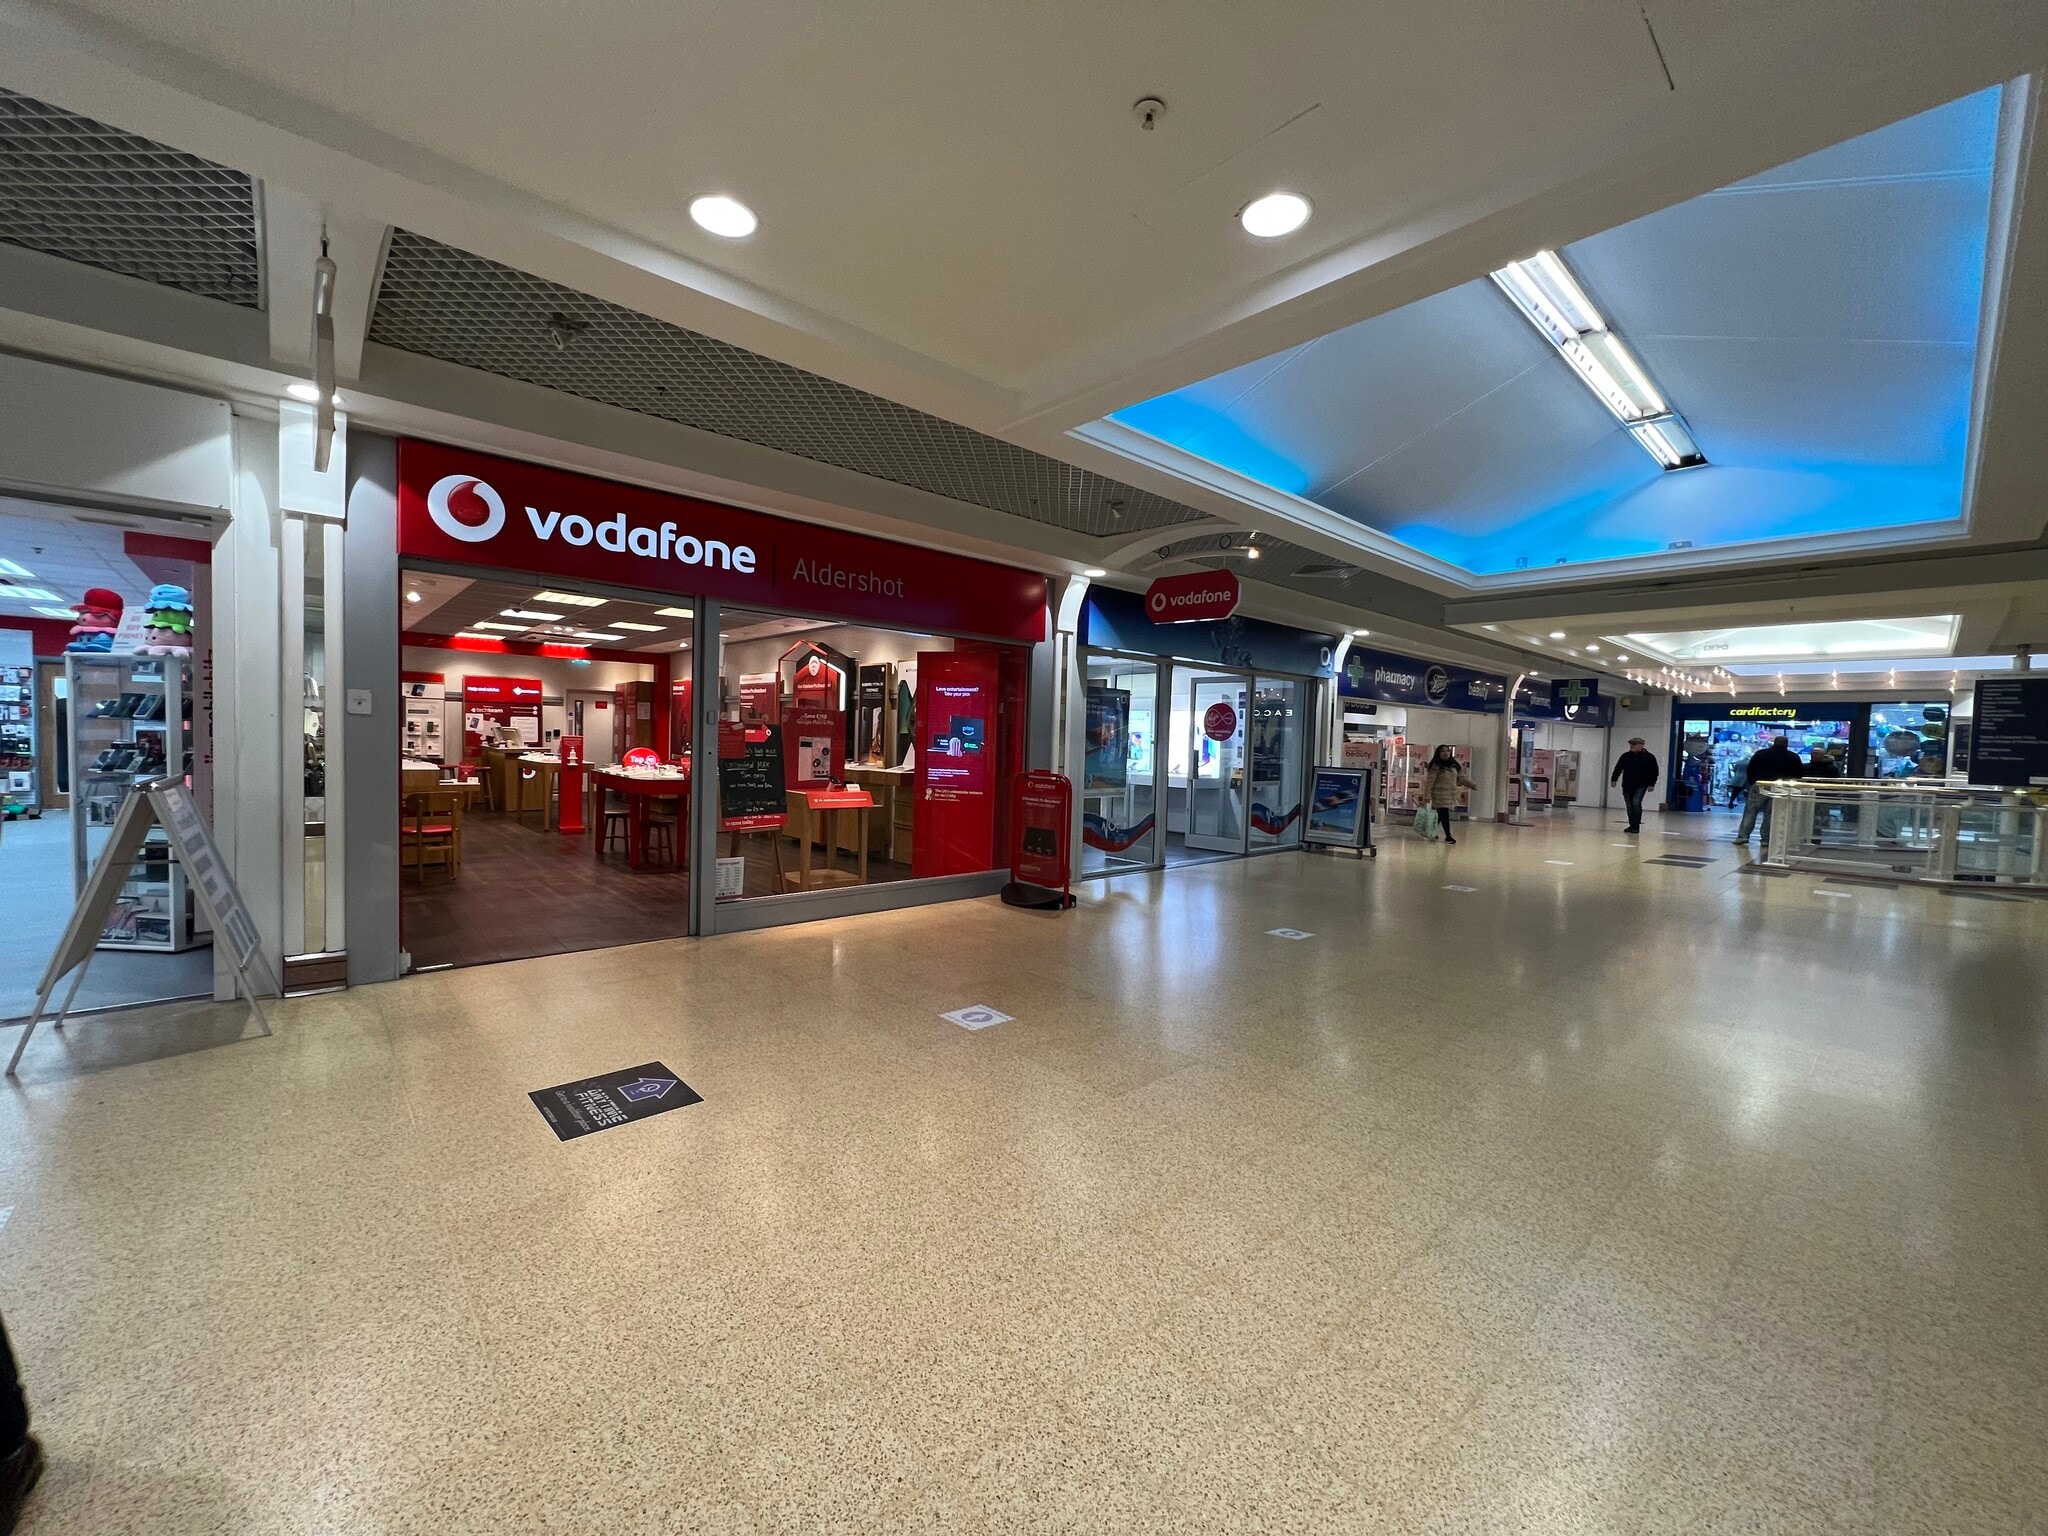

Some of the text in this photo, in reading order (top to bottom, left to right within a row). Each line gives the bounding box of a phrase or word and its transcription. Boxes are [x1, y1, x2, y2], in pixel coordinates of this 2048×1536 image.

[525, 506, 757, 573] vodafone
[793, 557, 905, 598] Aldershot
[1170, 590, 1232, 606] vodafone
[1375, 666, 1416, 690] pharmacy
[1729, 706, 1797, 718] cardfactory
[630, 755, 645, 764] Top
[1345, 751, 1372, 759] beauty
[574, 1091, 608, 1126] FITNESS
[586, 1088, 628, 1124] ANYTIME
